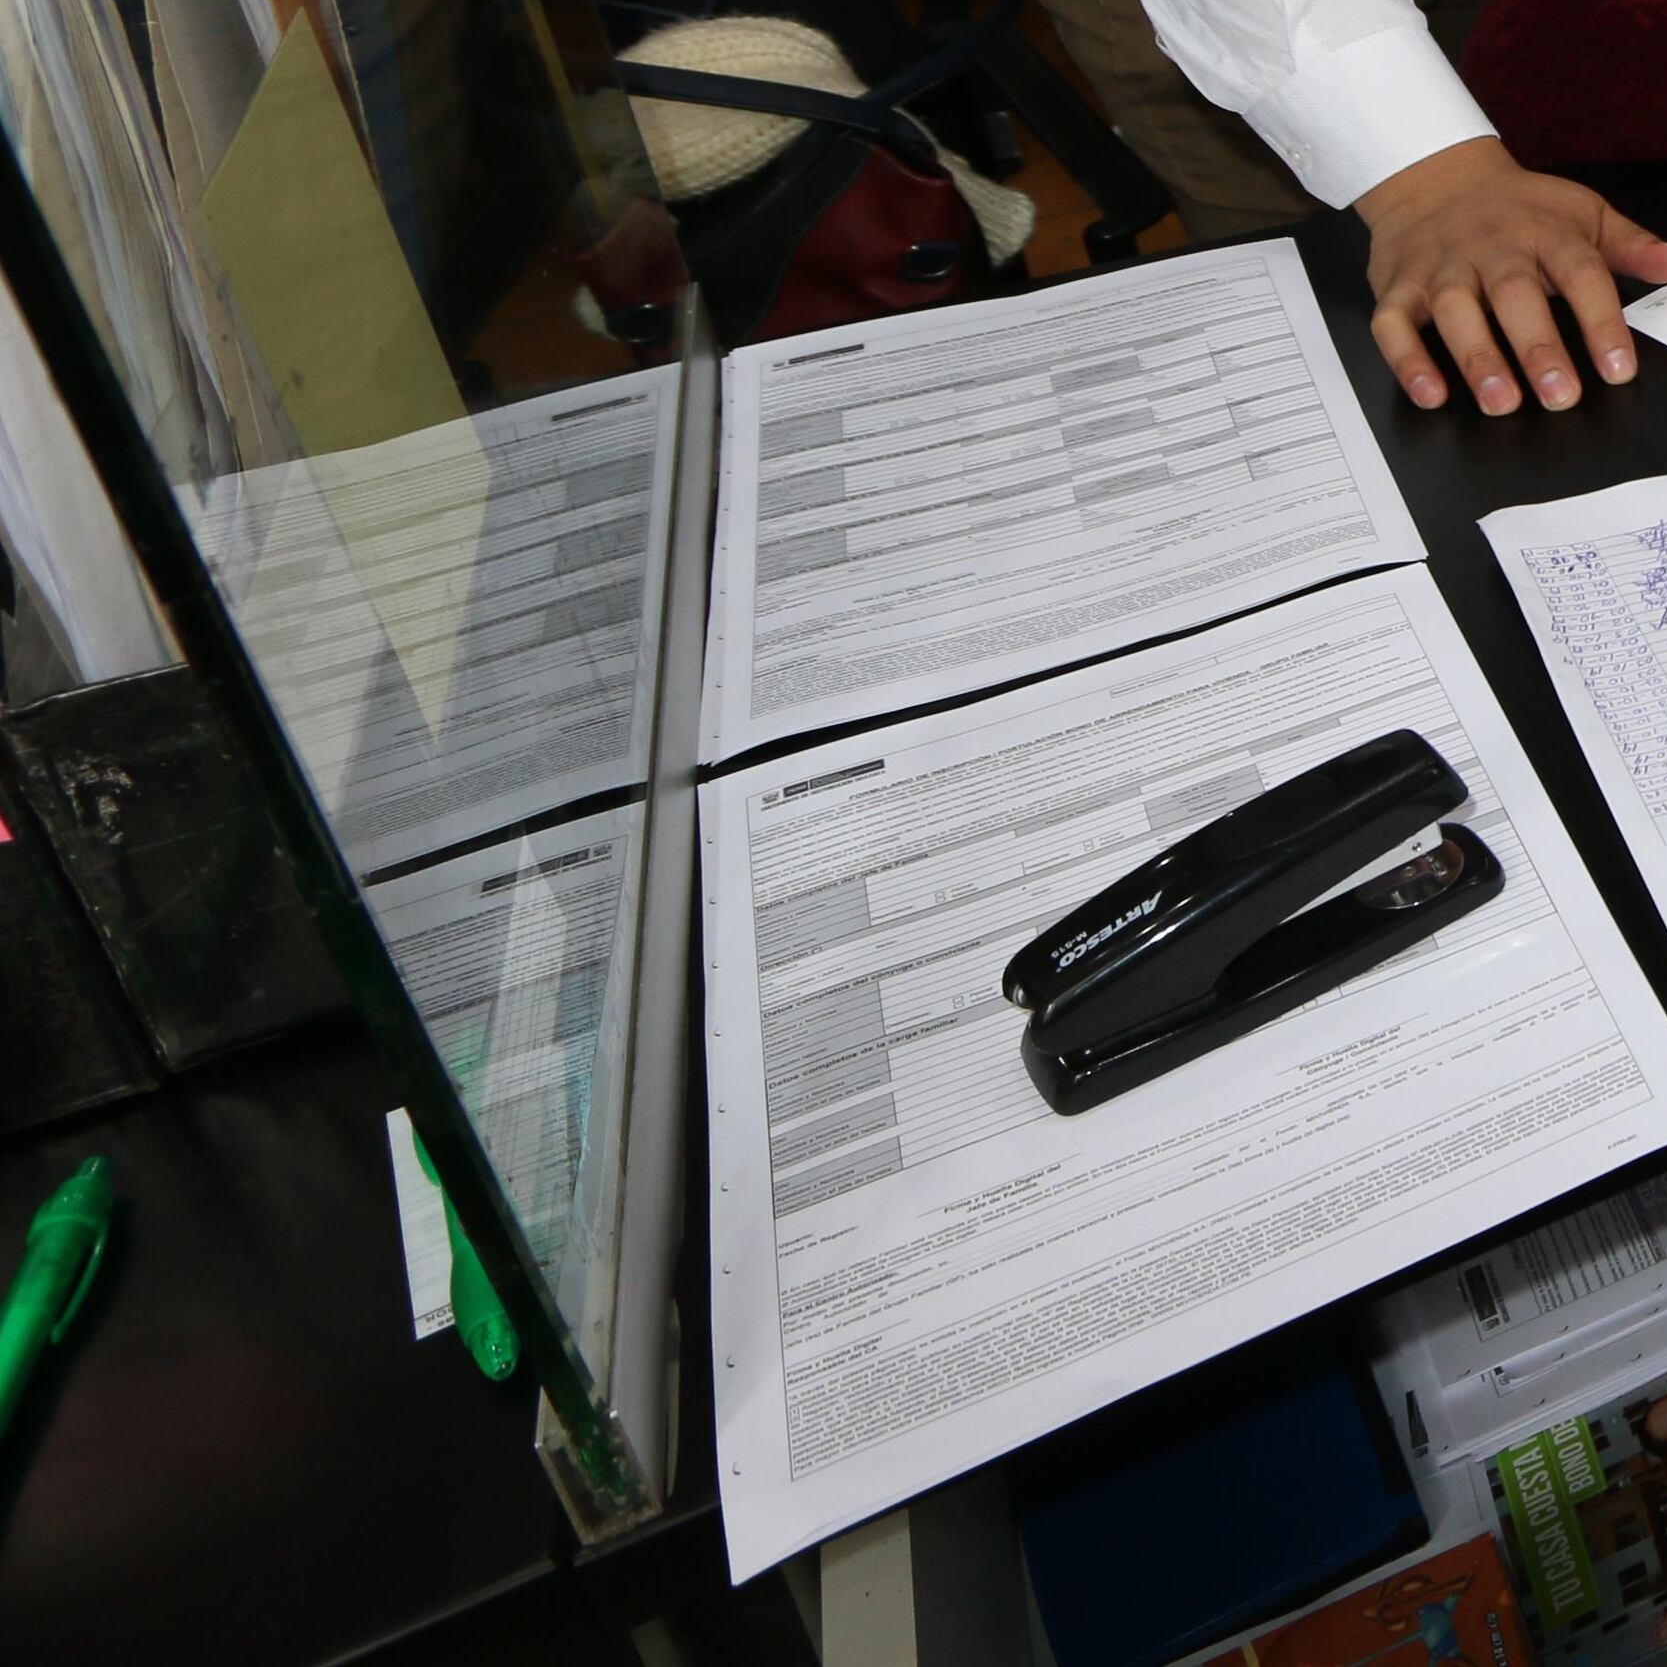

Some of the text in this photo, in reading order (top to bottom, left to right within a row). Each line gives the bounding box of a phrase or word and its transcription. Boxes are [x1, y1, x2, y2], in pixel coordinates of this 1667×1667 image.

[1058, 890, 1162, 968] ARTESCO
[1557, 1440, 1596, 1495] BONO
[1512, 1444, 1586, 1615] TU CASA CUESTA
